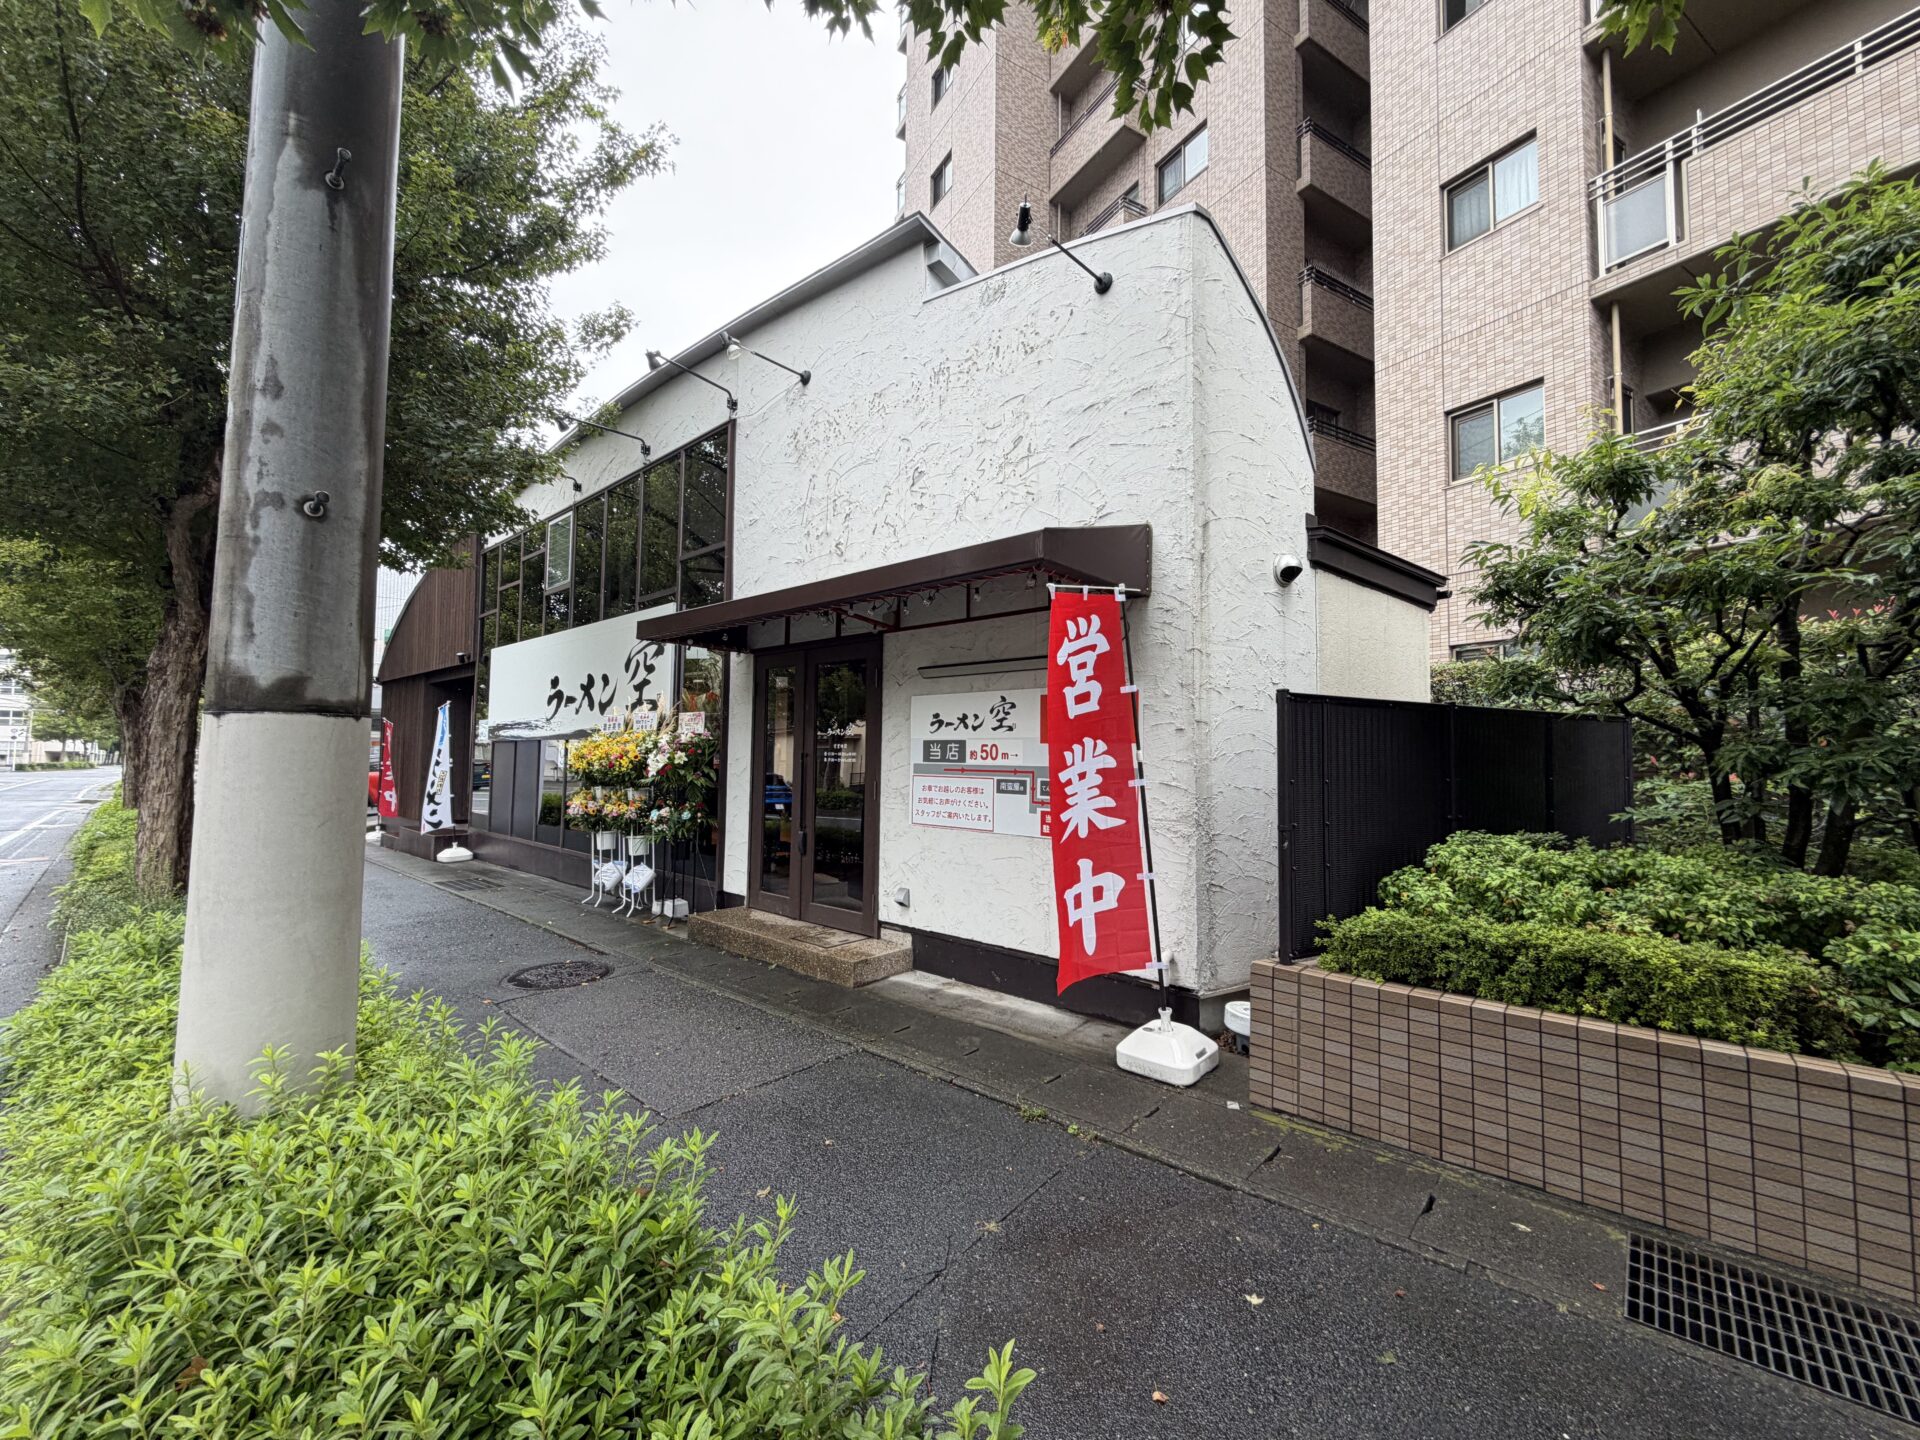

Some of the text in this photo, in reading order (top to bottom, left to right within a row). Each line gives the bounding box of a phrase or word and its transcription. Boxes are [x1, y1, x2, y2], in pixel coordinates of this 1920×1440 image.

[928, 695, 1017, 734] ラーメン空
[929, 742, 960, 760] 当店
[921, 784, 985, 795] お車でお越しのお客様は
[1056, 613, 1127, 956] 営業中
[914, 809, 992, 823] スタッフがご案内いたします。
